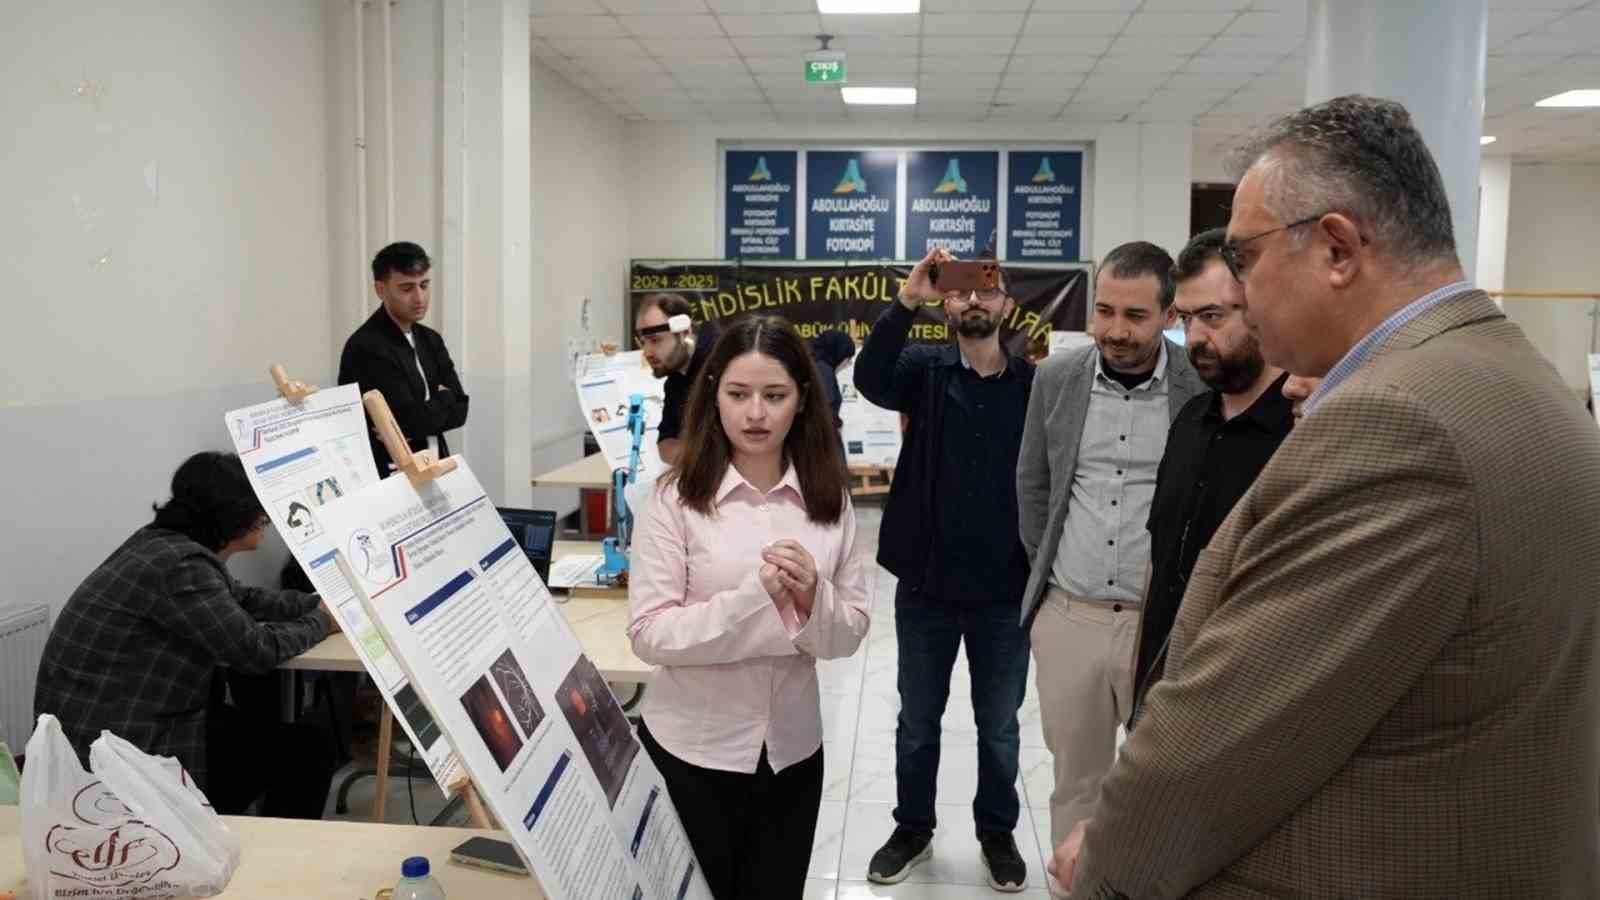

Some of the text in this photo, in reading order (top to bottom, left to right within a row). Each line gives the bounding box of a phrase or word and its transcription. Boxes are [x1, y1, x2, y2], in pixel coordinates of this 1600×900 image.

[811, 61, 839, 73] ÇIKIŞ
[811, 195, 889, 212] ABDULLAHOĞLU
[912, 195, 991, 213] ABDULLAHOĞLU
[829, 215, 875, 232] KIRTASİYE
[929, 216, 975, 233] KIRTASİYE
[826, 235, 874, 252] FOTOKOPİ
[926, 236, 975, 253] FOTOKOPİ
[633, 274, 668, 289] 2024
[689, 276, 802, 325] ENDİSLİK
